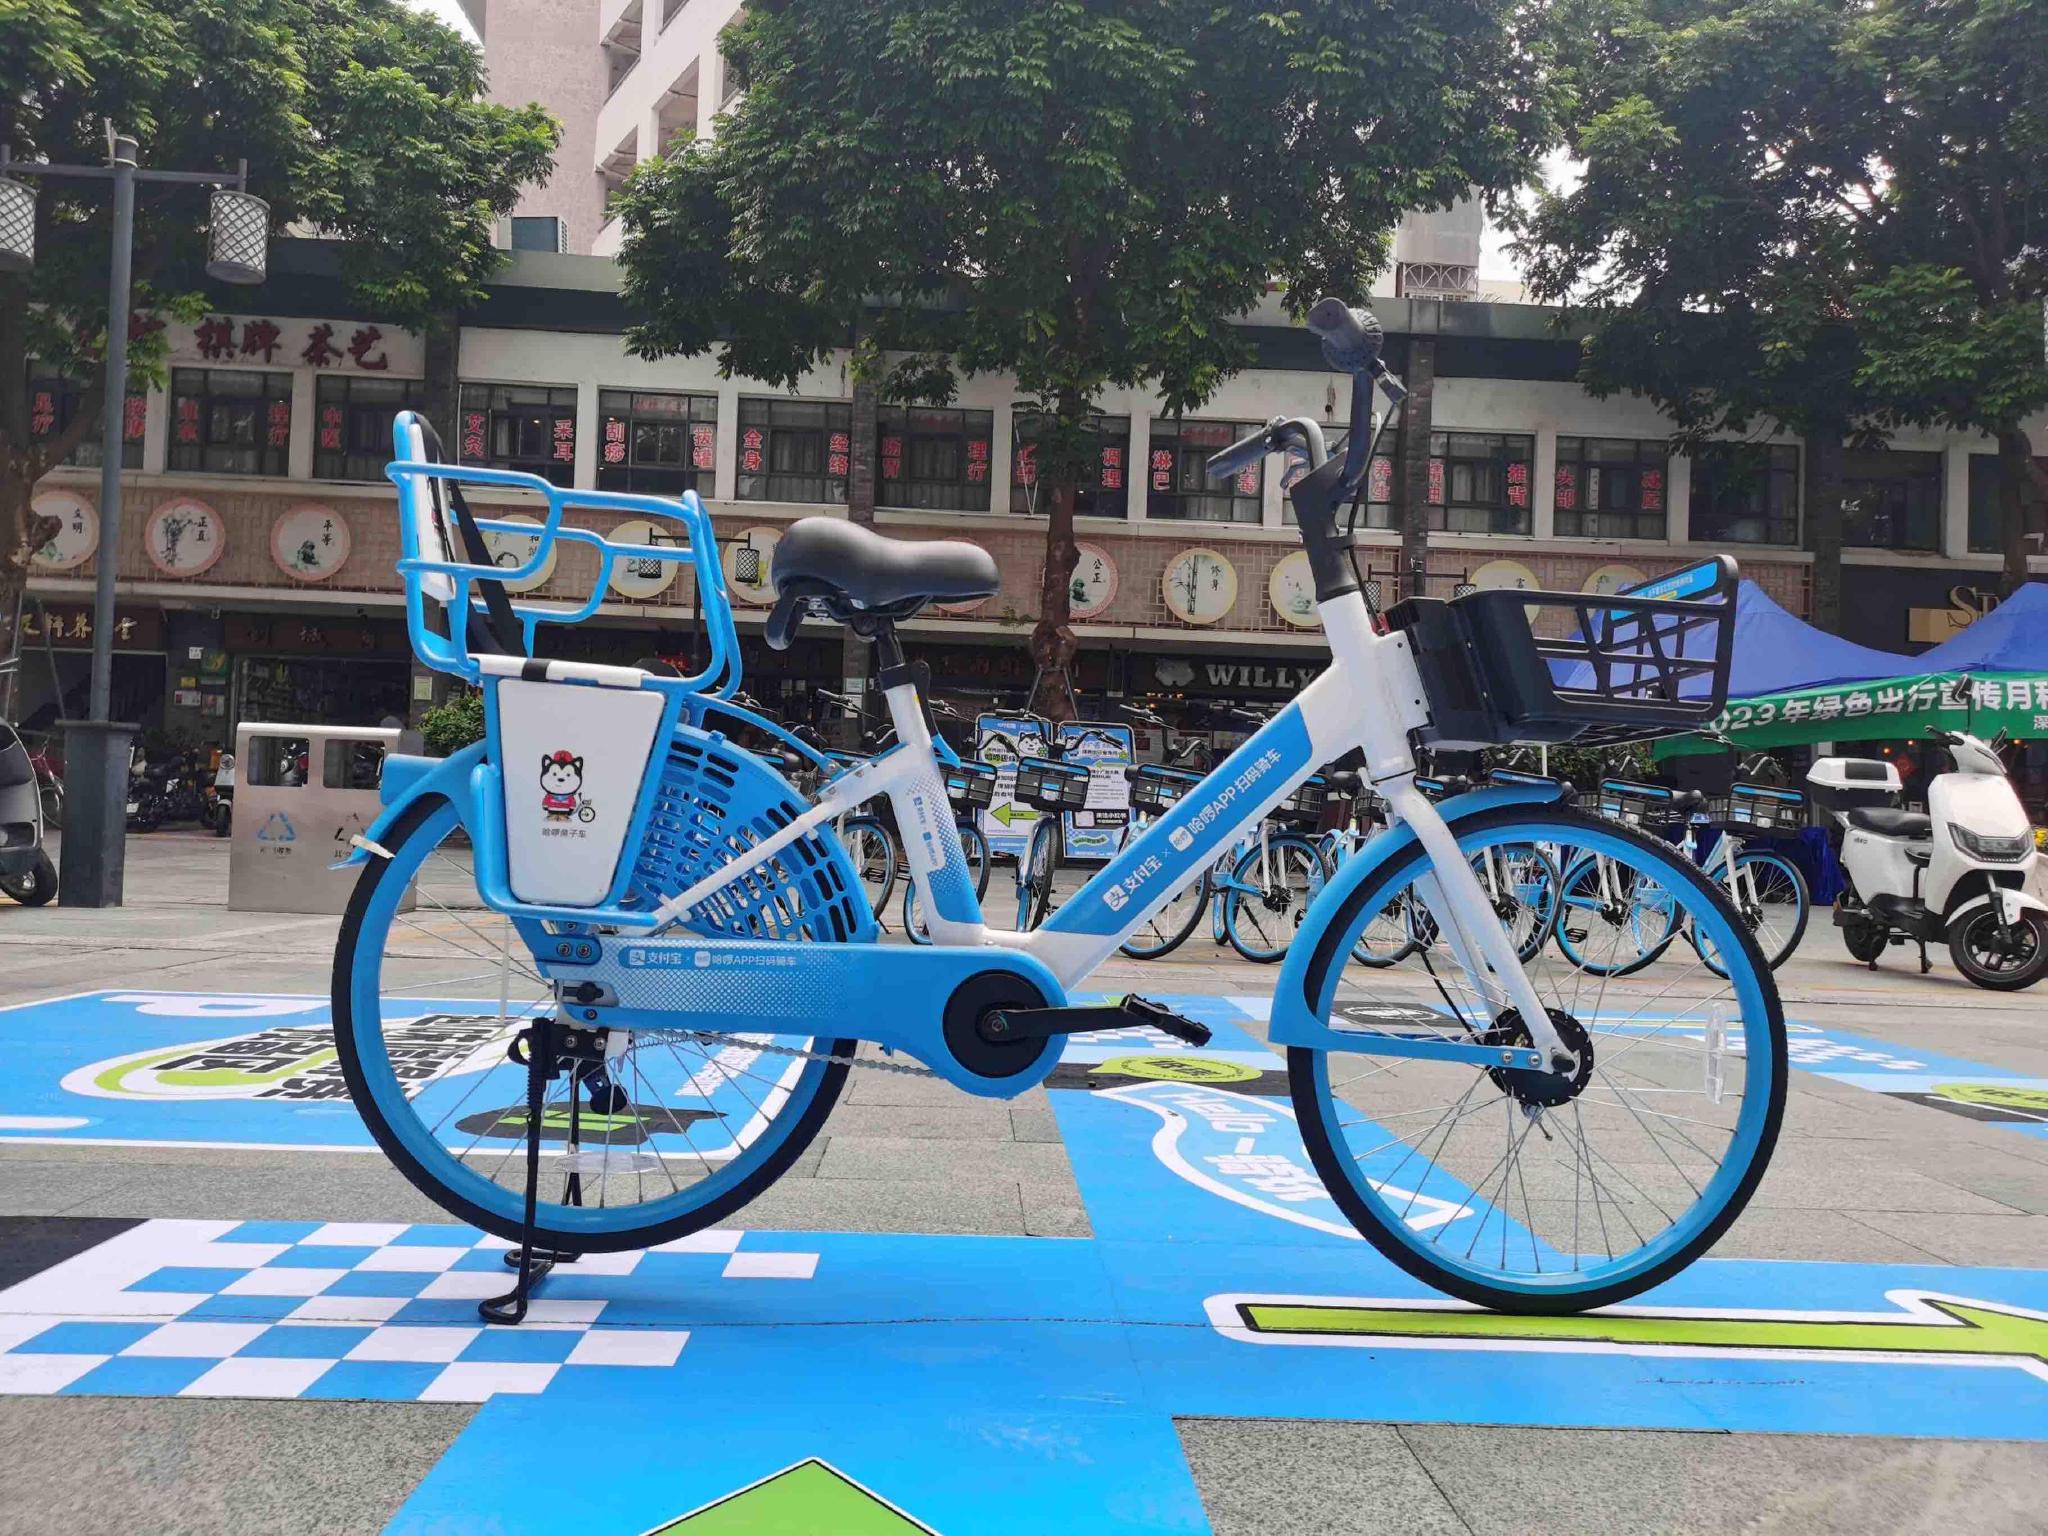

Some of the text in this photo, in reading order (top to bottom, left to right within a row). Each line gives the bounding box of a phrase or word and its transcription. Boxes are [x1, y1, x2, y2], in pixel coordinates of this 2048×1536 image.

[193, 316, 282, 364] 棋牌
[301, 323, 388, 371] 茶艺
[464, 412, 486, 459] 艾灸
[553, 419, 574, 462] 采耳
[604, 421, 626, 464] 刮痧
[692, 427, 714, 470] 拔罐
[828, 432, 849, 476] 经络
[1101, 448, 1121, 489] 调理
[1152, 449, 1173, 491] 淋巴
[1506, 462, 1528, 507] 推背
[1556, 468, 1575, 509] 头部
[1092, 558, 1103, 584] 公正
[1709, 680, 2048, 736] 023年绿色出行宣传月
[1122, 855, 1163, 895] 支付宝
[647, 952, 682, 965] 支付宝
